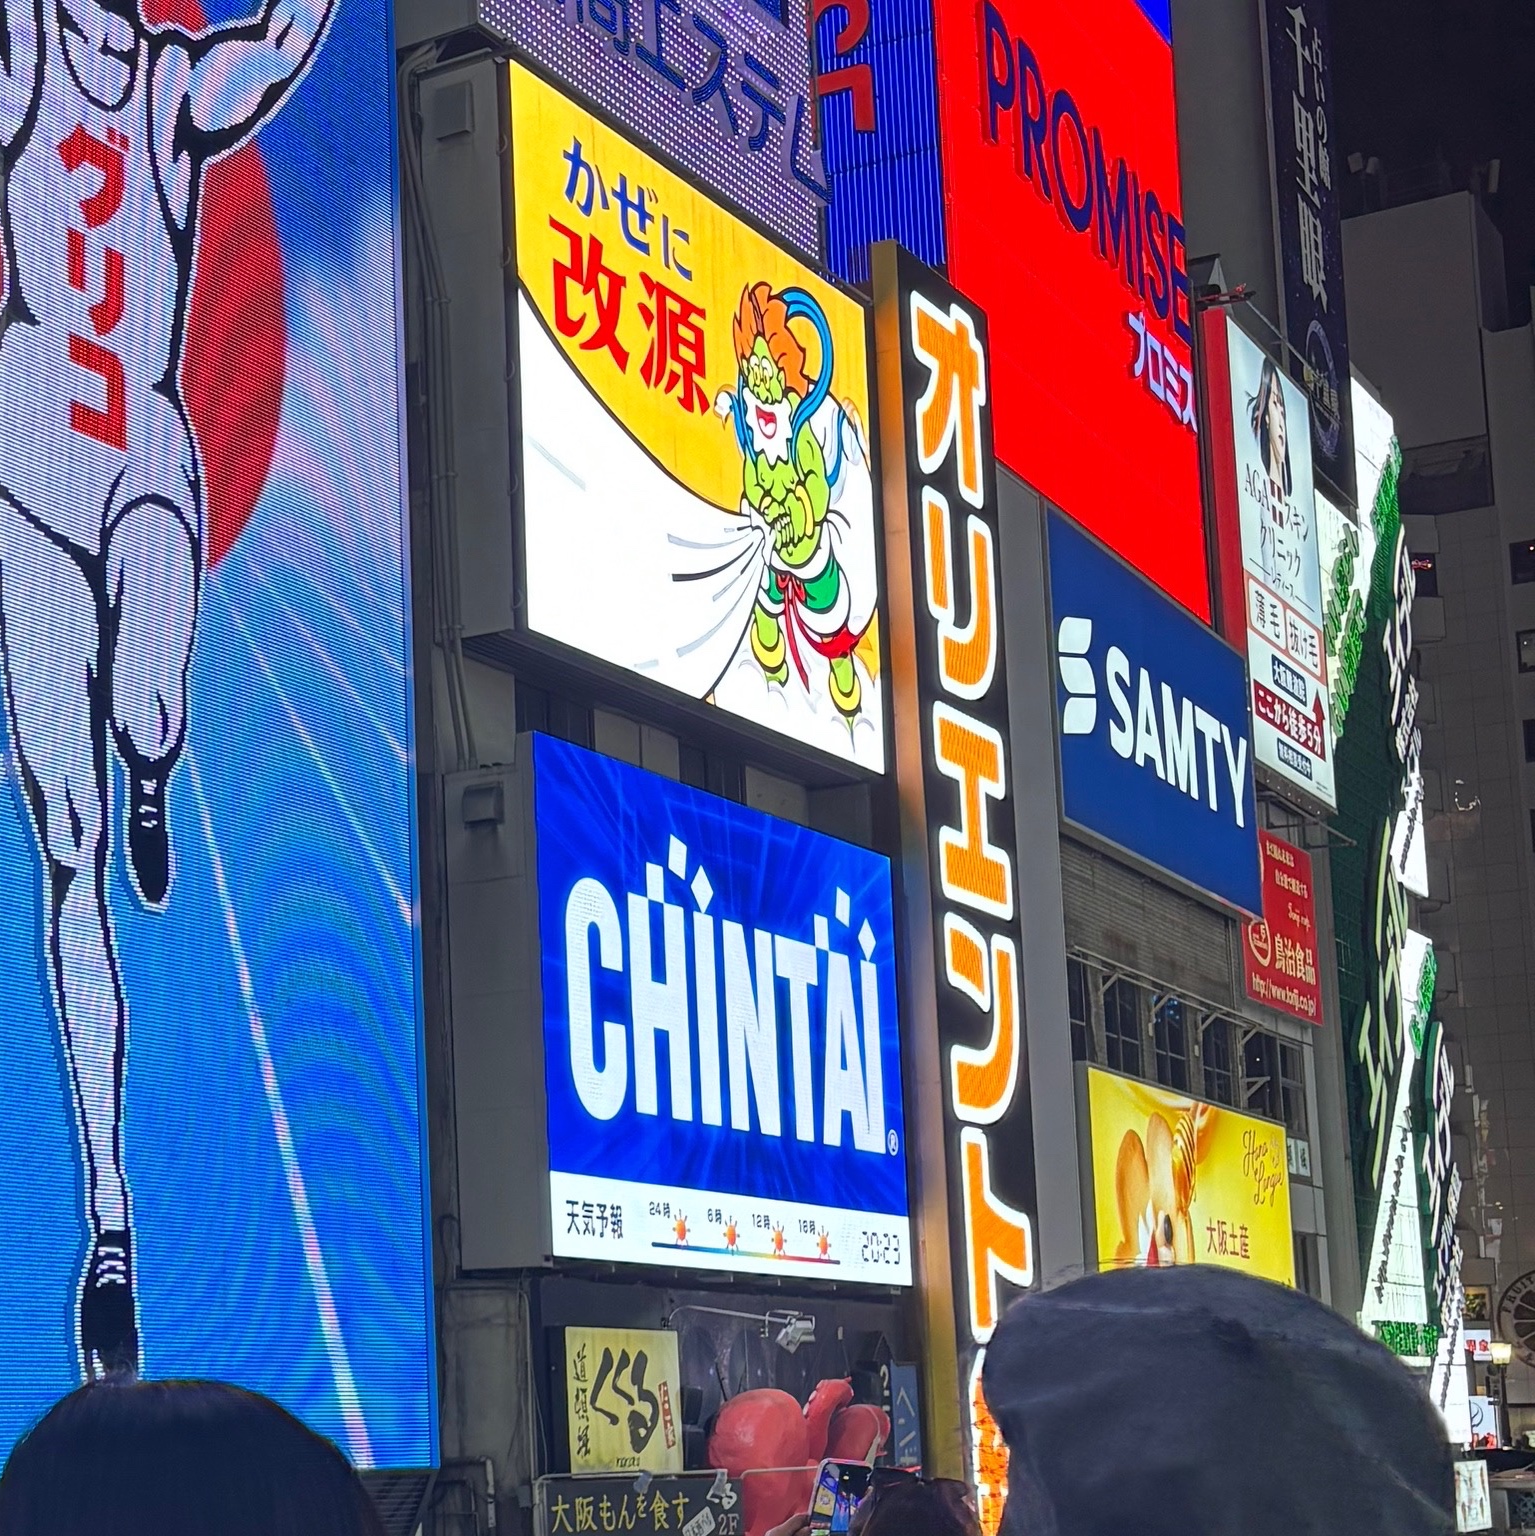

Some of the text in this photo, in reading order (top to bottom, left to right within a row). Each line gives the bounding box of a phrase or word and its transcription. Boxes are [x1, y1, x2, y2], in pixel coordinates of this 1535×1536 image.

[562, 136, 694, 282] かぜに
[983, 3, 1192, 348] PROMISE
[59, 121, 130, 453] グリコ
[548, 214, 711, 417] 改源
[1128, 310, 1199, 435] プロミス
[1244, 462, 1310, 543] AGA スキン
[1260, 518, 1302, 578] クリニック
[1106, 645, 1247, 829] SAMTY
[565, 1199, 624, 1240] 天気予報
[861, 1230, 901, 1266] 20:23
[1206, 1216, 1251, 1261] 大阪土産
[551, 1489, 690, 1534] 大阪もんを食す
[718, 1513, 740, 1536] 2F
